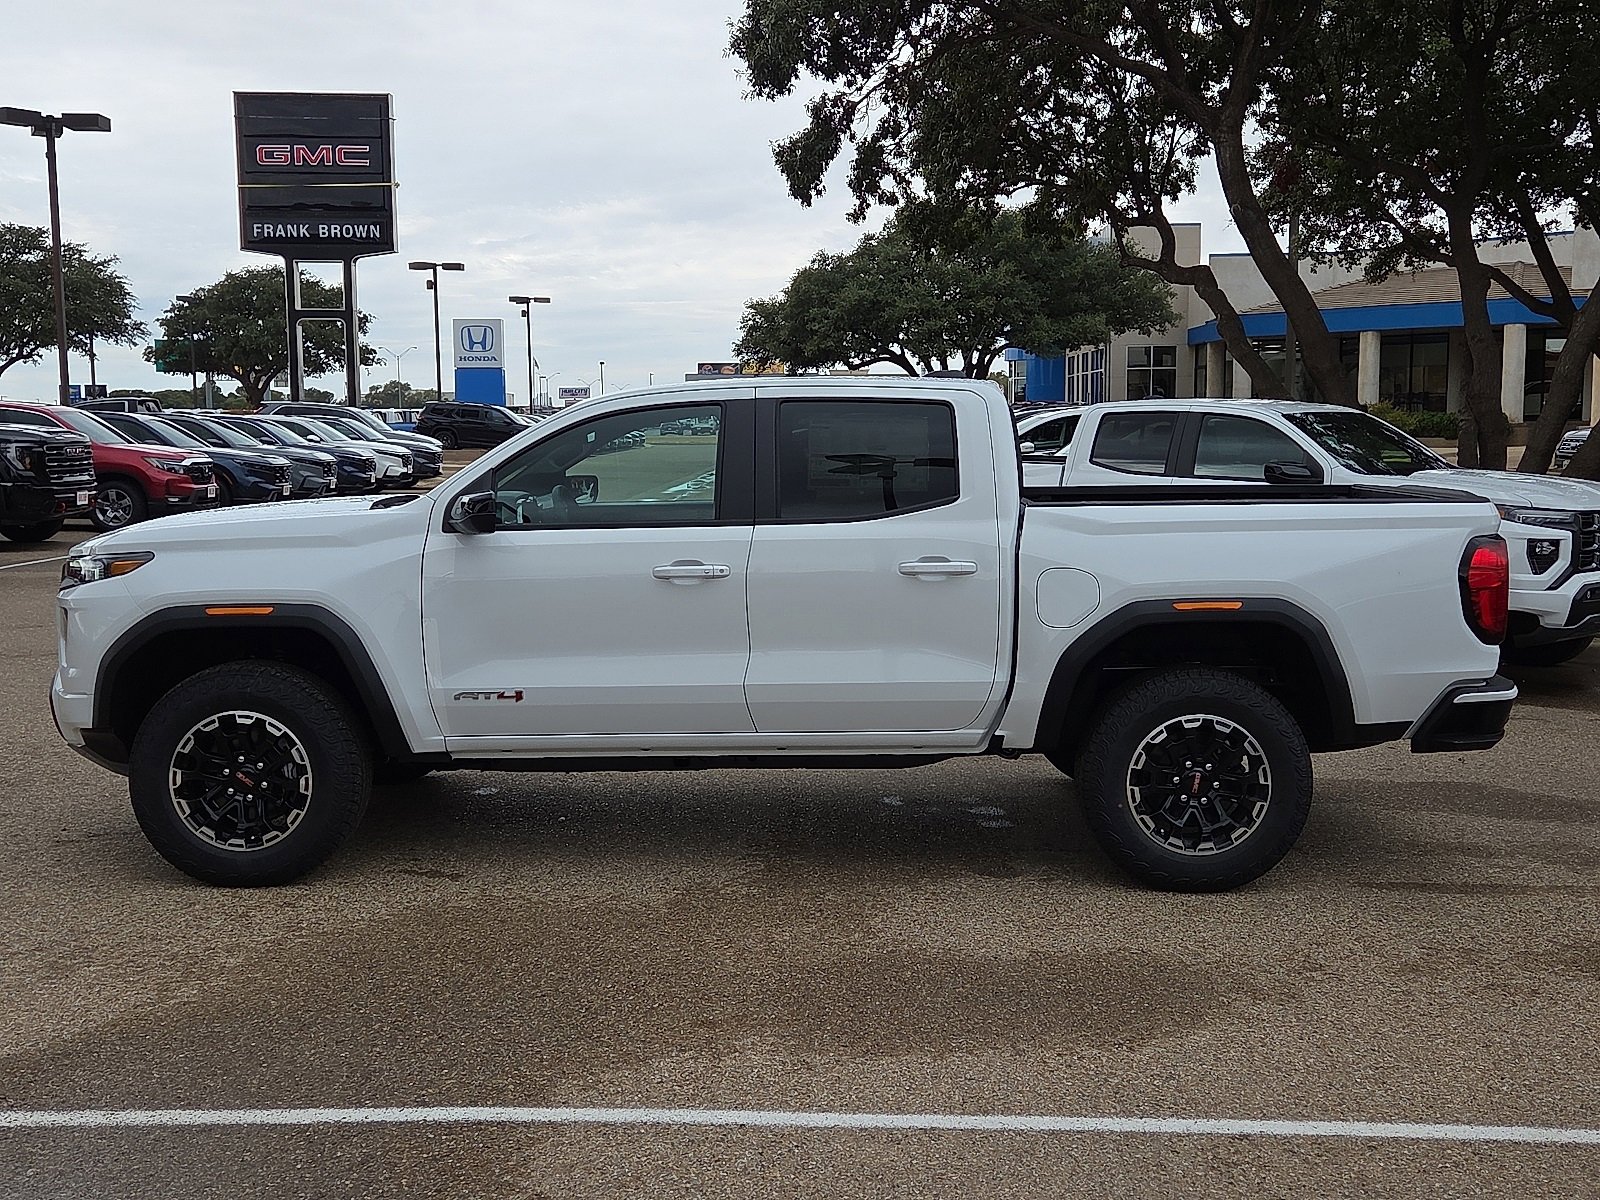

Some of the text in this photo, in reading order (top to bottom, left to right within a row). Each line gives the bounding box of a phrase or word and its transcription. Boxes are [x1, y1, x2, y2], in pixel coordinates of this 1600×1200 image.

[256, 144, 370, 167] GMC
[253, 223, 380, 238] FRANK BROWN
